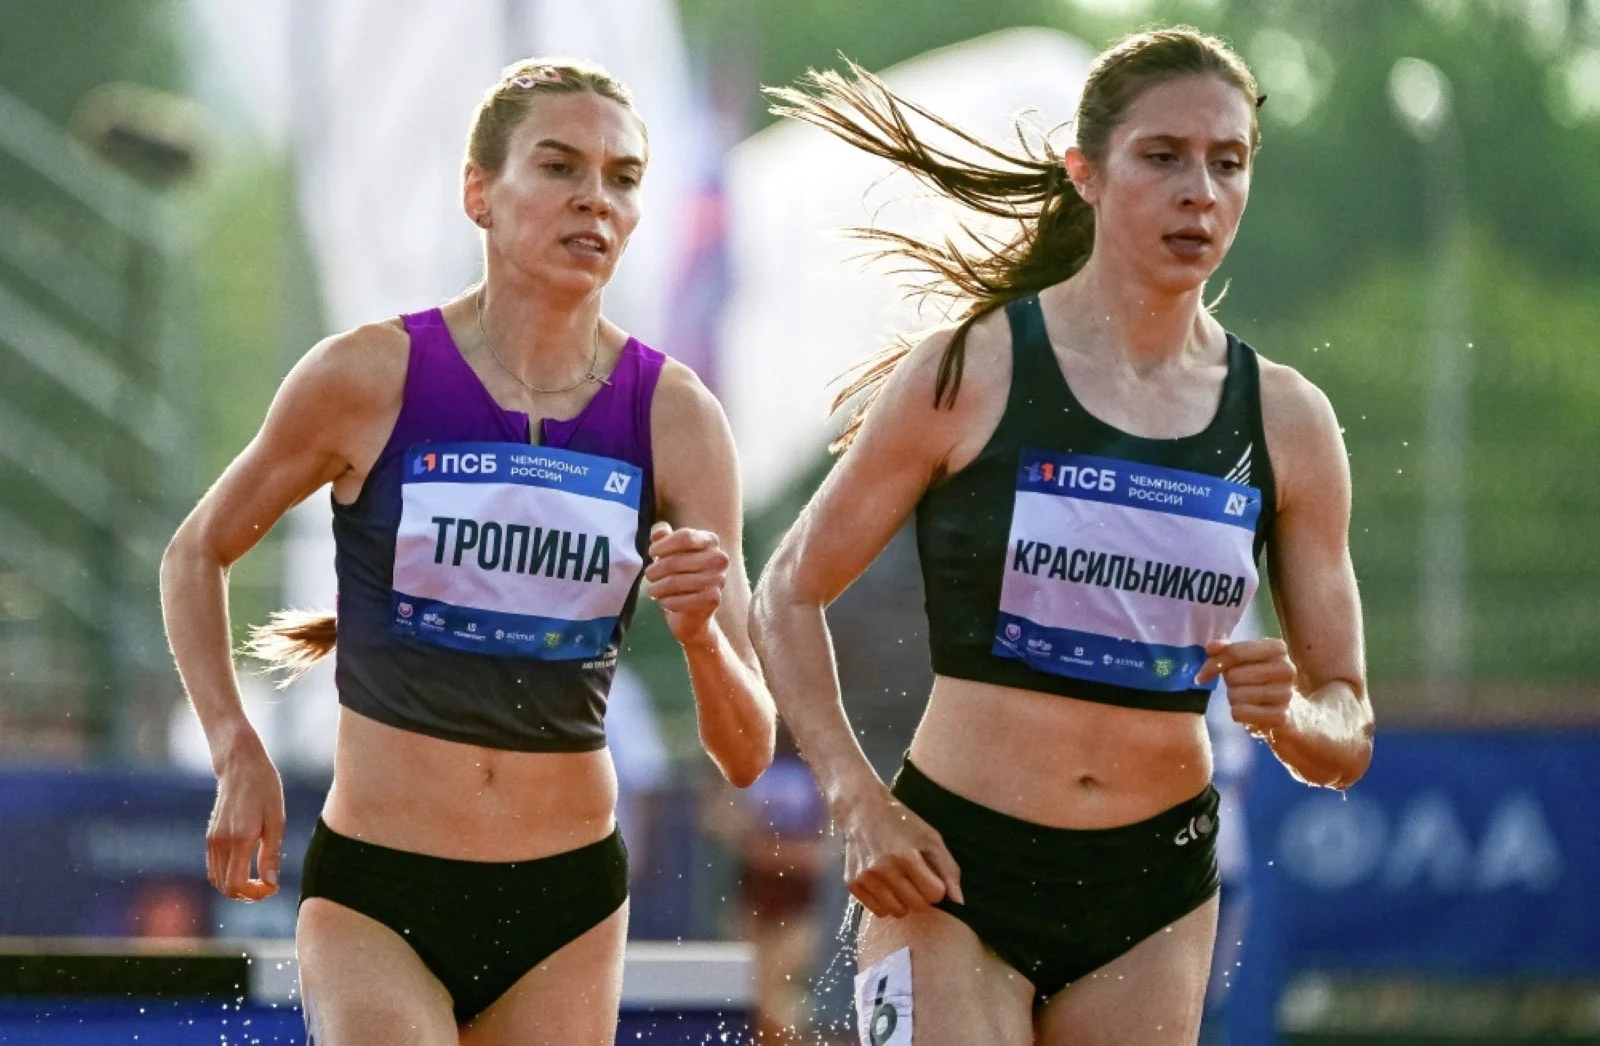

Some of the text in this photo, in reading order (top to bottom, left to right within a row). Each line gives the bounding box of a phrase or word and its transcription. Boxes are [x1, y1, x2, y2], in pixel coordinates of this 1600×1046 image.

[441, 453, 497, 474] ПСБ
[510, 454, 589, 477] ЧЕМПИОНАТ
[510, 467, 562, 483] РОССИИ
[1057, 465, 1116, 492] ПСБ
[1129, 474, 1212, 498] ЧЕМПИОНАТ
[1128, 487, 1183, 506] РОССИИ
[431, 516, 611, 584] ТРОПИНА
[1012, 539, 1246, 608] КРАСИЛЬНИКОВА
